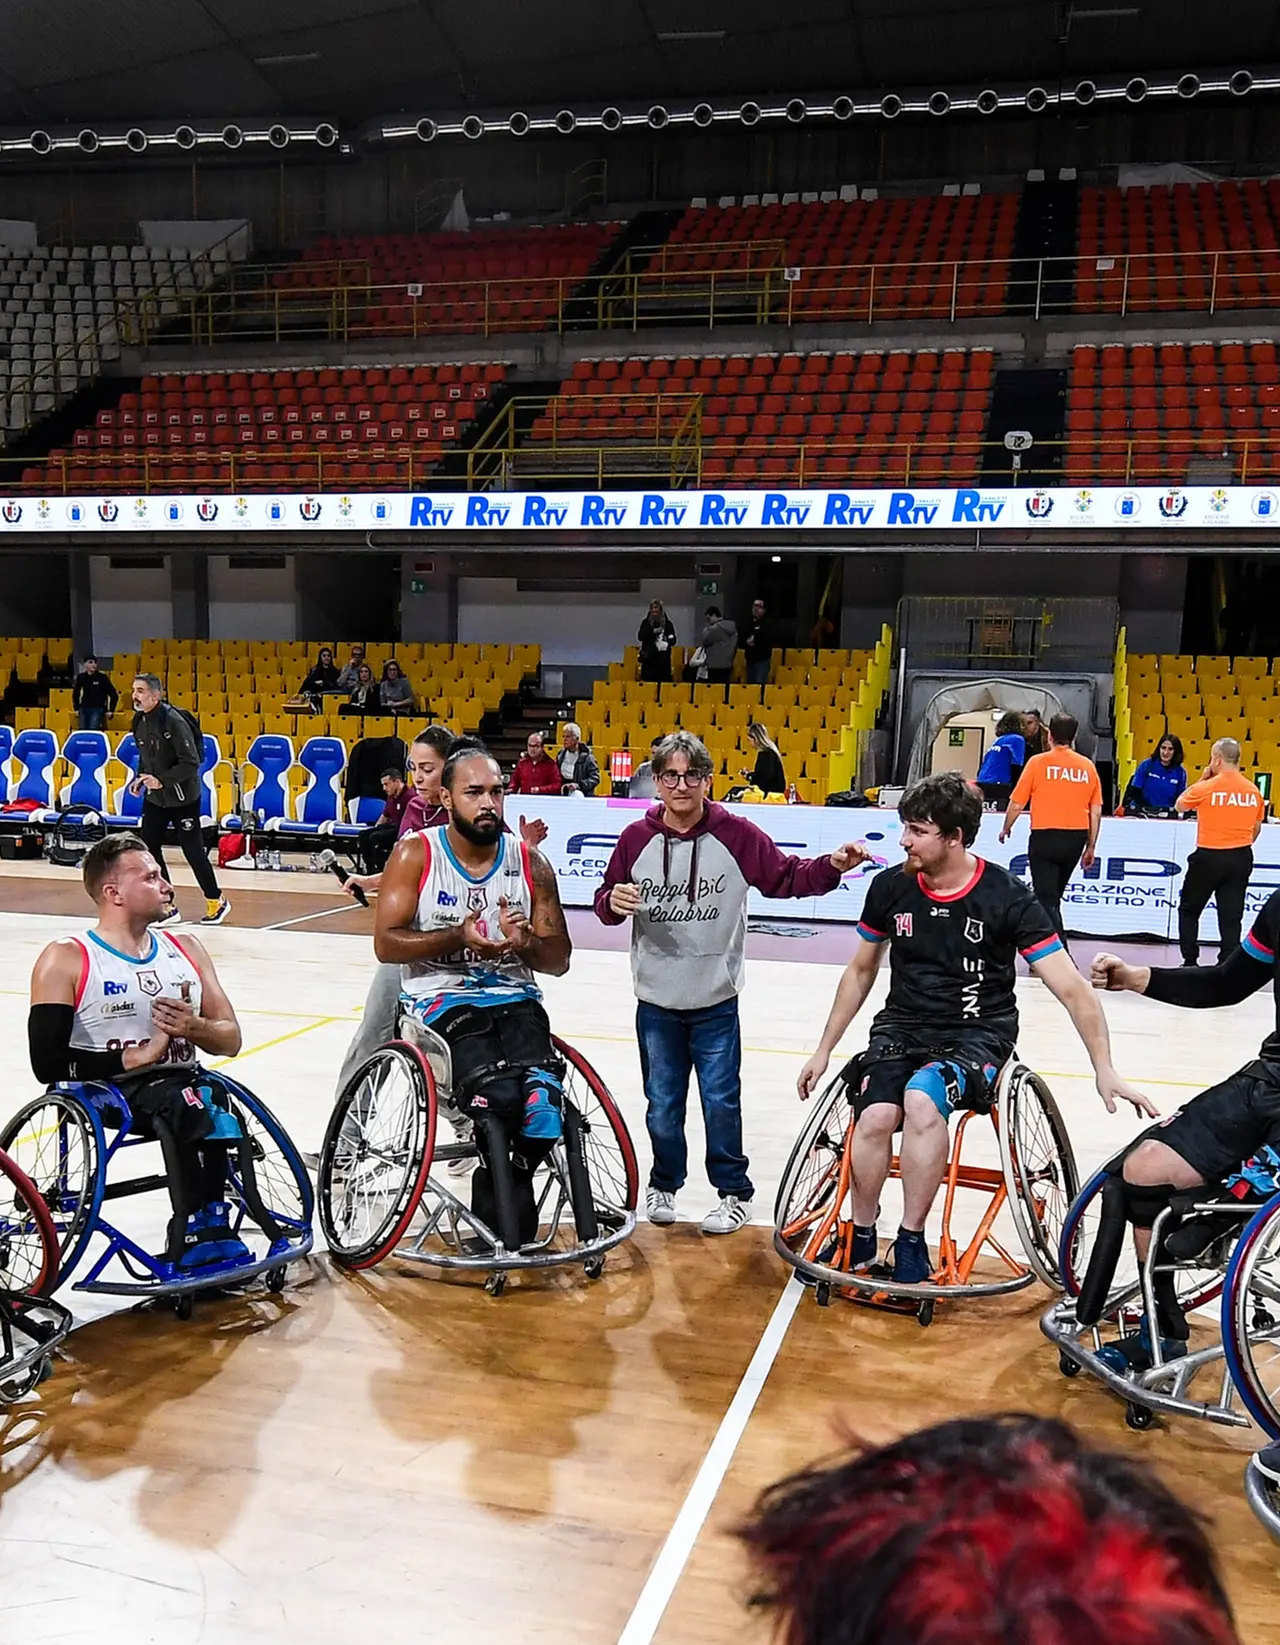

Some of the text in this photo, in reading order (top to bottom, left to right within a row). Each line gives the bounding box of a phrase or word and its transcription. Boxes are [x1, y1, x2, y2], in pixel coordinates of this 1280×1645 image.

[1046, 766, 1090, 784] ITALIA
[1211, 792, 1258, 807] ITALIA
[649, 904, 720, 923] Calabria
[893, 912, 913, 937] 14
